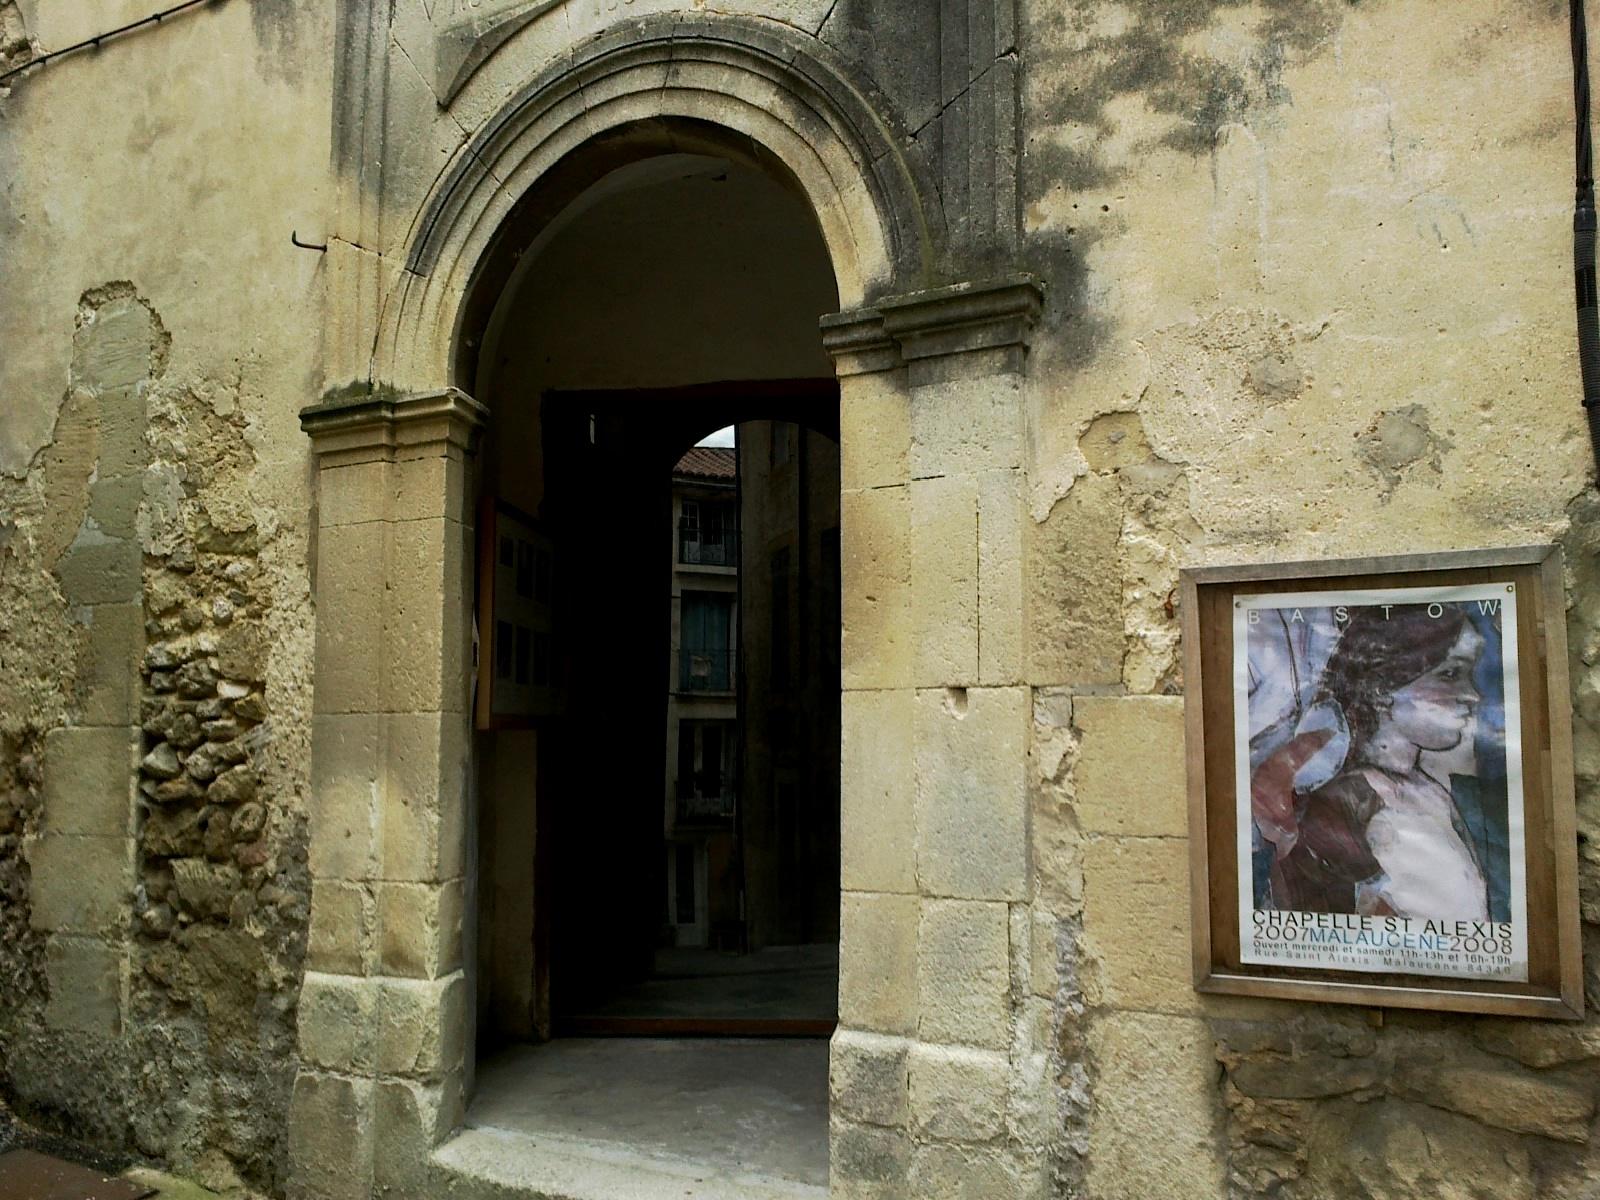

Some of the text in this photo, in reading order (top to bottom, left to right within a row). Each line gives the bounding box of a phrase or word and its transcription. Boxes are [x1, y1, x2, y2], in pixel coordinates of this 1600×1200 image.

[1248, 599, 1501, 625] BASTOW
[1252, 909, 1512, 939] CHAPELLE ST ALEXIS
[1253, 939, 1288, 950] Ouvert
[1292, 942, 1338, 953] mercredi
[1342, 944, 1353, 954] et
[1357, 946, 1394, 956] samedi
[1400, 949, 1444, 960] 11h-13h
[1448, 952, 1459, 963] et
[1254, 948, 1279, 958] Rue
[1286, 950, 1321, 961] Saint
